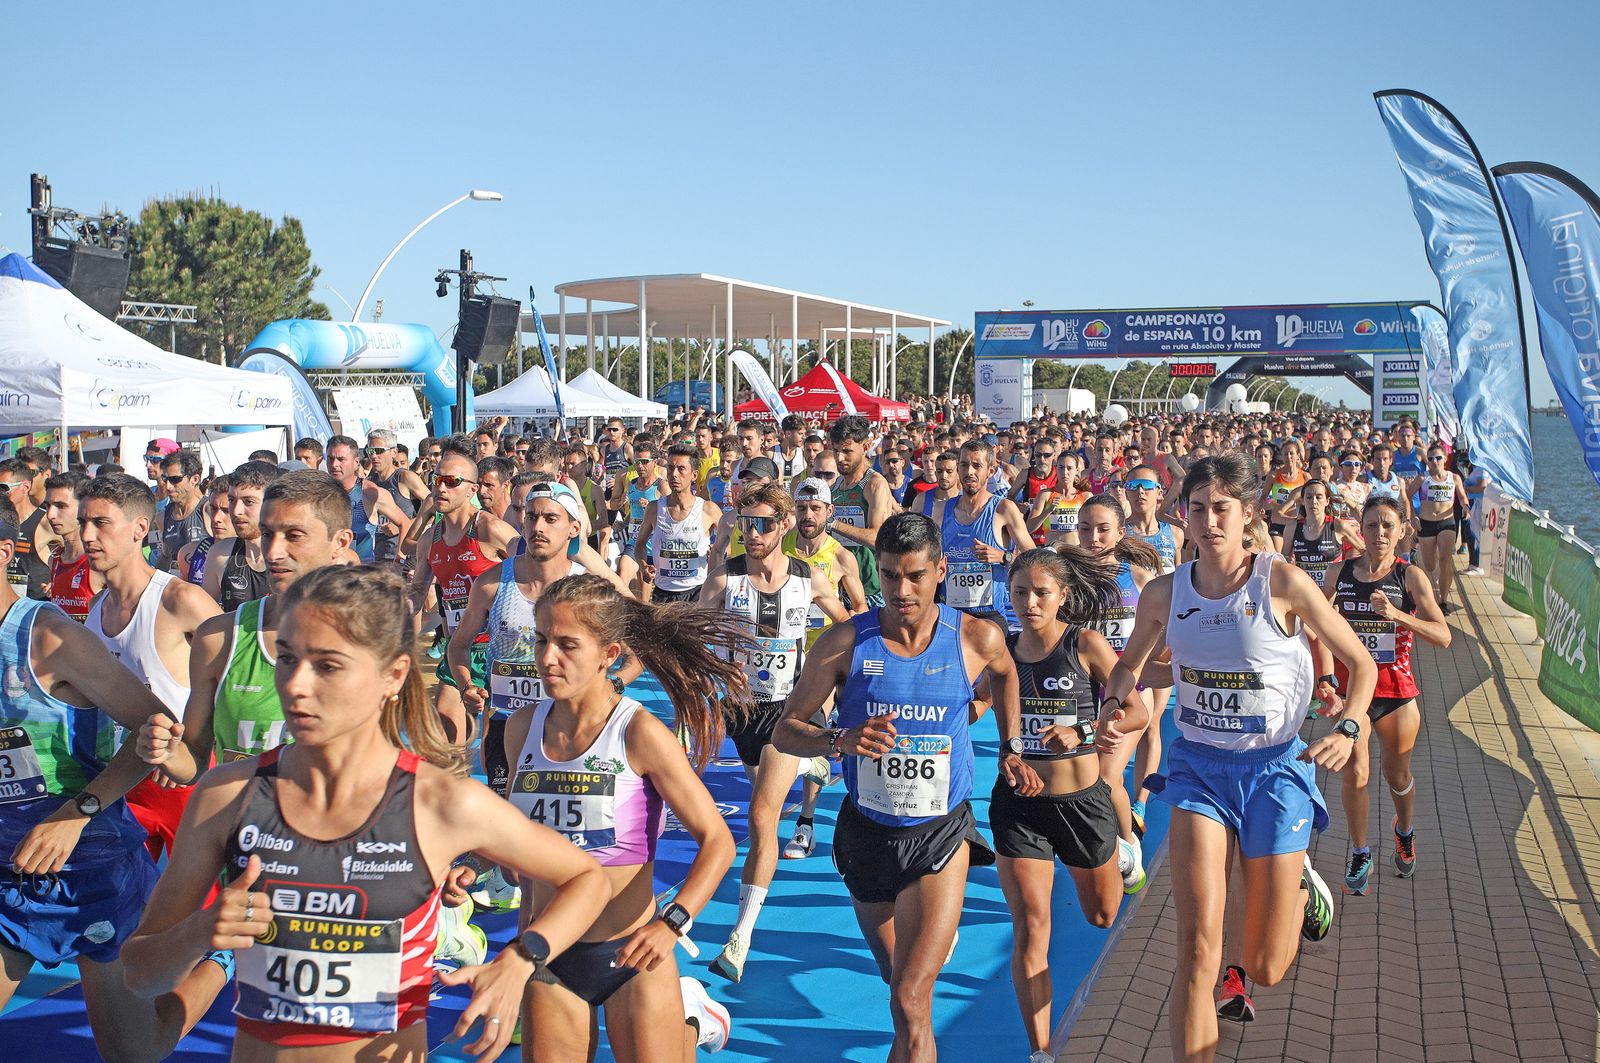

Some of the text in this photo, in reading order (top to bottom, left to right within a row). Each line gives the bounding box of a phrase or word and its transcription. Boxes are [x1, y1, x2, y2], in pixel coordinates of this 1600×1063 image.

[1125, 313, 1226, 326] CAMPEONATO
[1125, 325, 1262, 341] de ESPAÑA 10 km
[1301, 320, 1344, 333] HUELVA
[368, 332, 401, 350] HUELVA
[1191, 342, 1225, 350] Absoluto
[669, 560, 689, 569] 183
[953, 575, 984, 587] 1898
[1204, 671, 1254, 681] RUNNING
[1043, 676, 1074, 690] GO
[1195, 690, 1241, 714] 404
[866, 702, 948, 722] URUGUAY
[918, 741, 942, 752] 2023
[873, 757, 935, 779] 1886
[546, 773, 600, 783] RUNNING
[558, 785, 589, 794] LOOP
[893, 801, 917, 809] Syrluz
[530, 798, 582, 828] 415
[238, 824, 294, 852] Bilbao
[352, 862, 413, 873] Bizkaialde
[305, 892, 356, 915] BM
[289, 921, 382, 938] RUNNING
[311, 938, 365, 951] LOOP
[266, 955, 352, 999] 405
